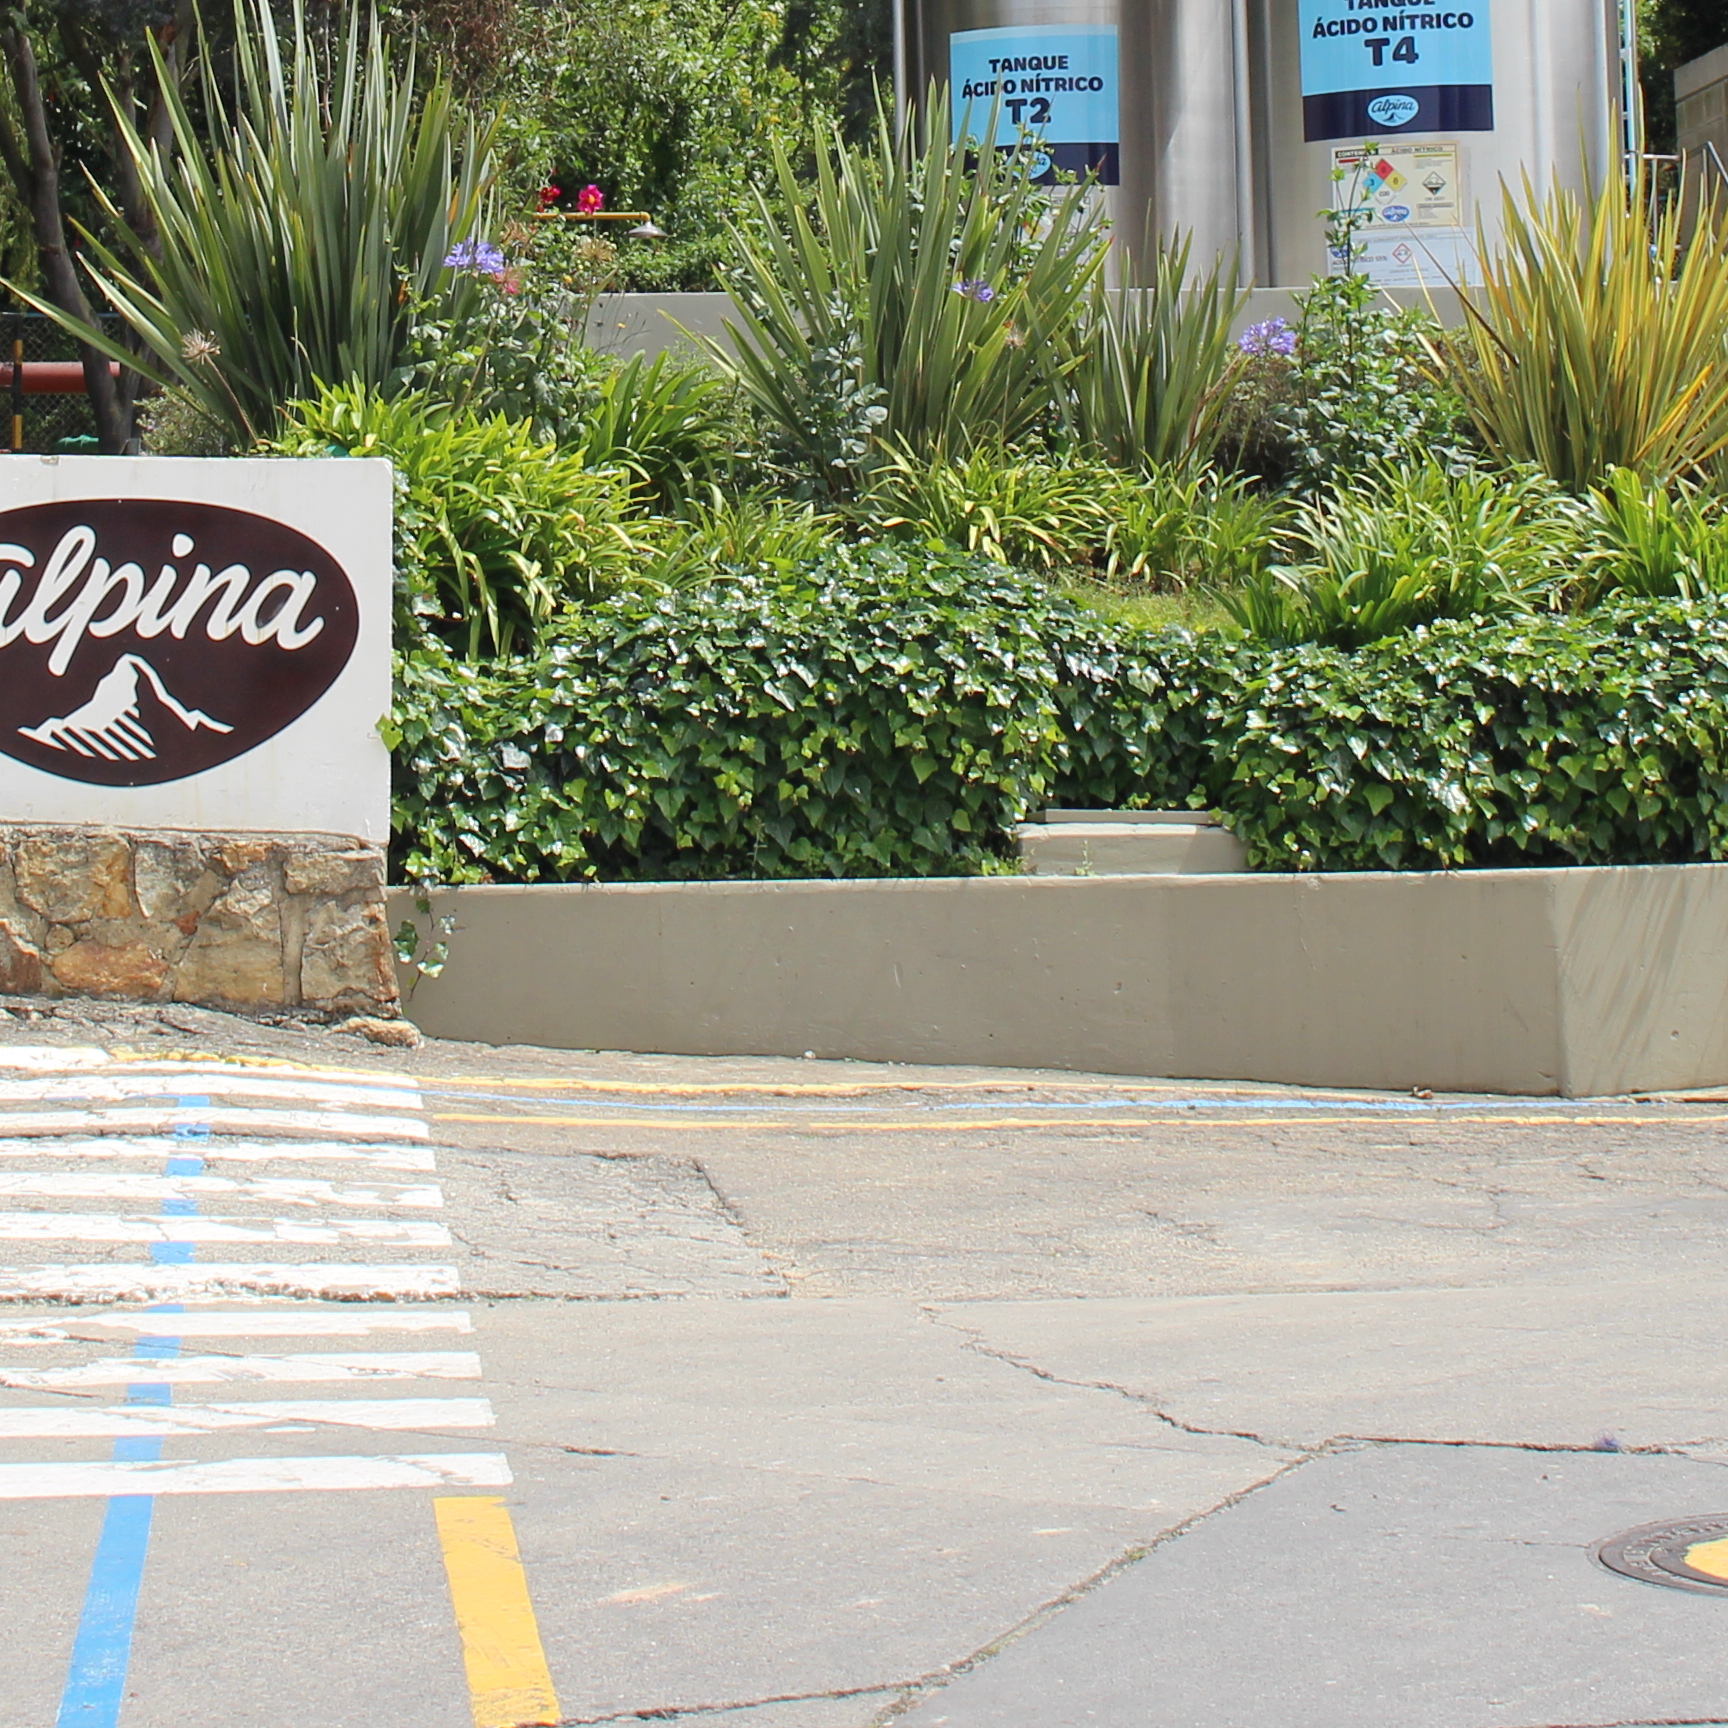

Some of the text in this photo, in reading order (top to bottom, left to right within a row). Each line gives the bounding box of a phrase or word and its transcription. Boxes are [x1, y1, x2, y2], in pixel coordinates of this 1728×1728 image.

[1312, 10, 1474, 39] ÁCIDO NÍTRICO
[988, 55, 1069, 74] TANQUE
[1364, 36, 1419, 66] T4
[1020, 73, 1104, 93] NÍTRICO
[1005, 97, 1052, 125] T2
